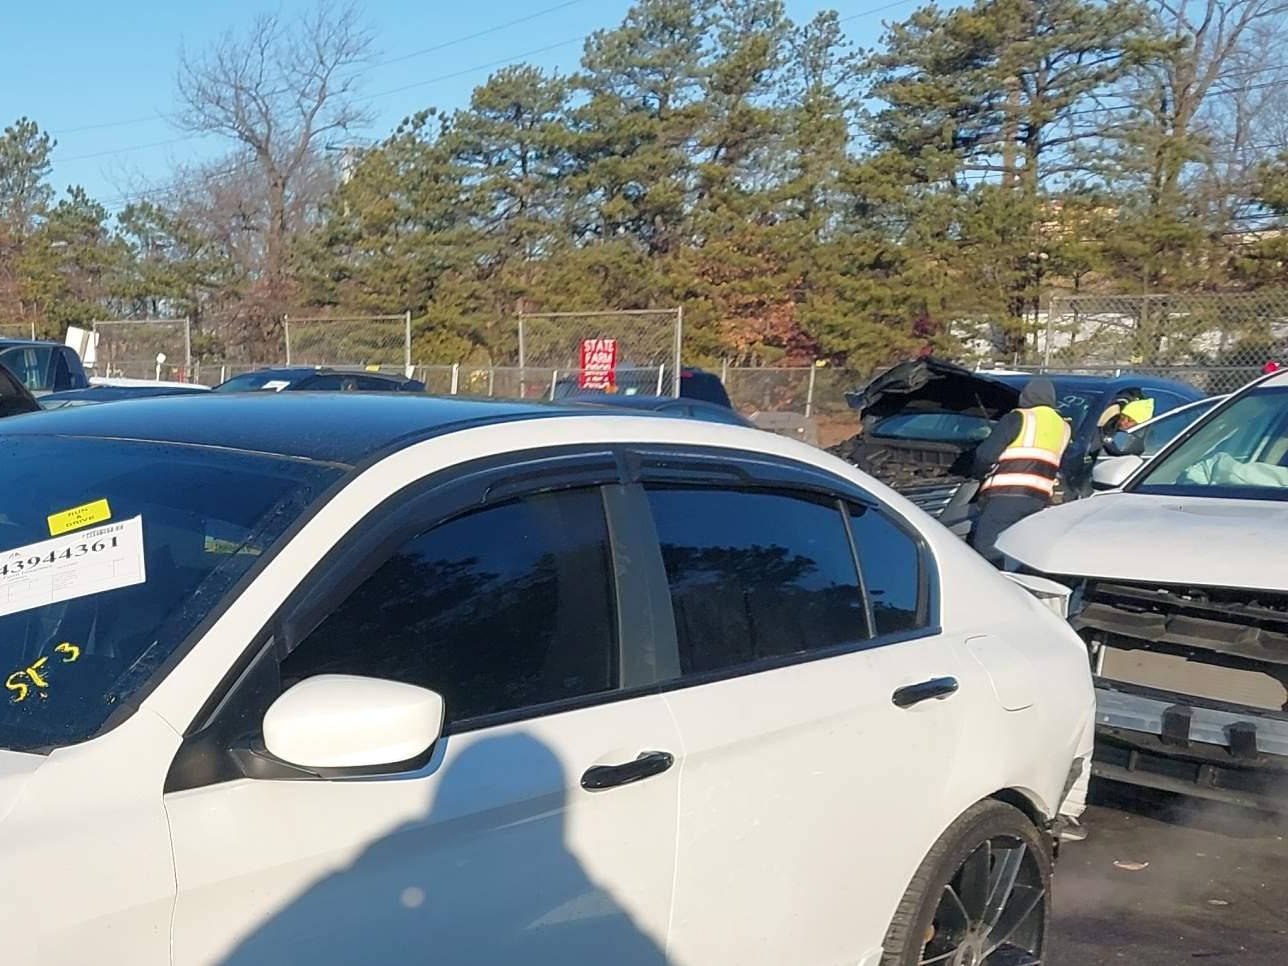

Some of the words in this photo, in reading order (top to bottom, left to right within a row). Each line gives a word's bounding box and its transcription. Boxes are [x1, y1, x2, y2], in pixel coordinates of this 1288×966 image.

[583, 339, 615, 352] STATE
[584, 352, 614, 364] FARM
[67, 507, 89, 518] RUN
[65, 515, 96, 528] DRIVE
